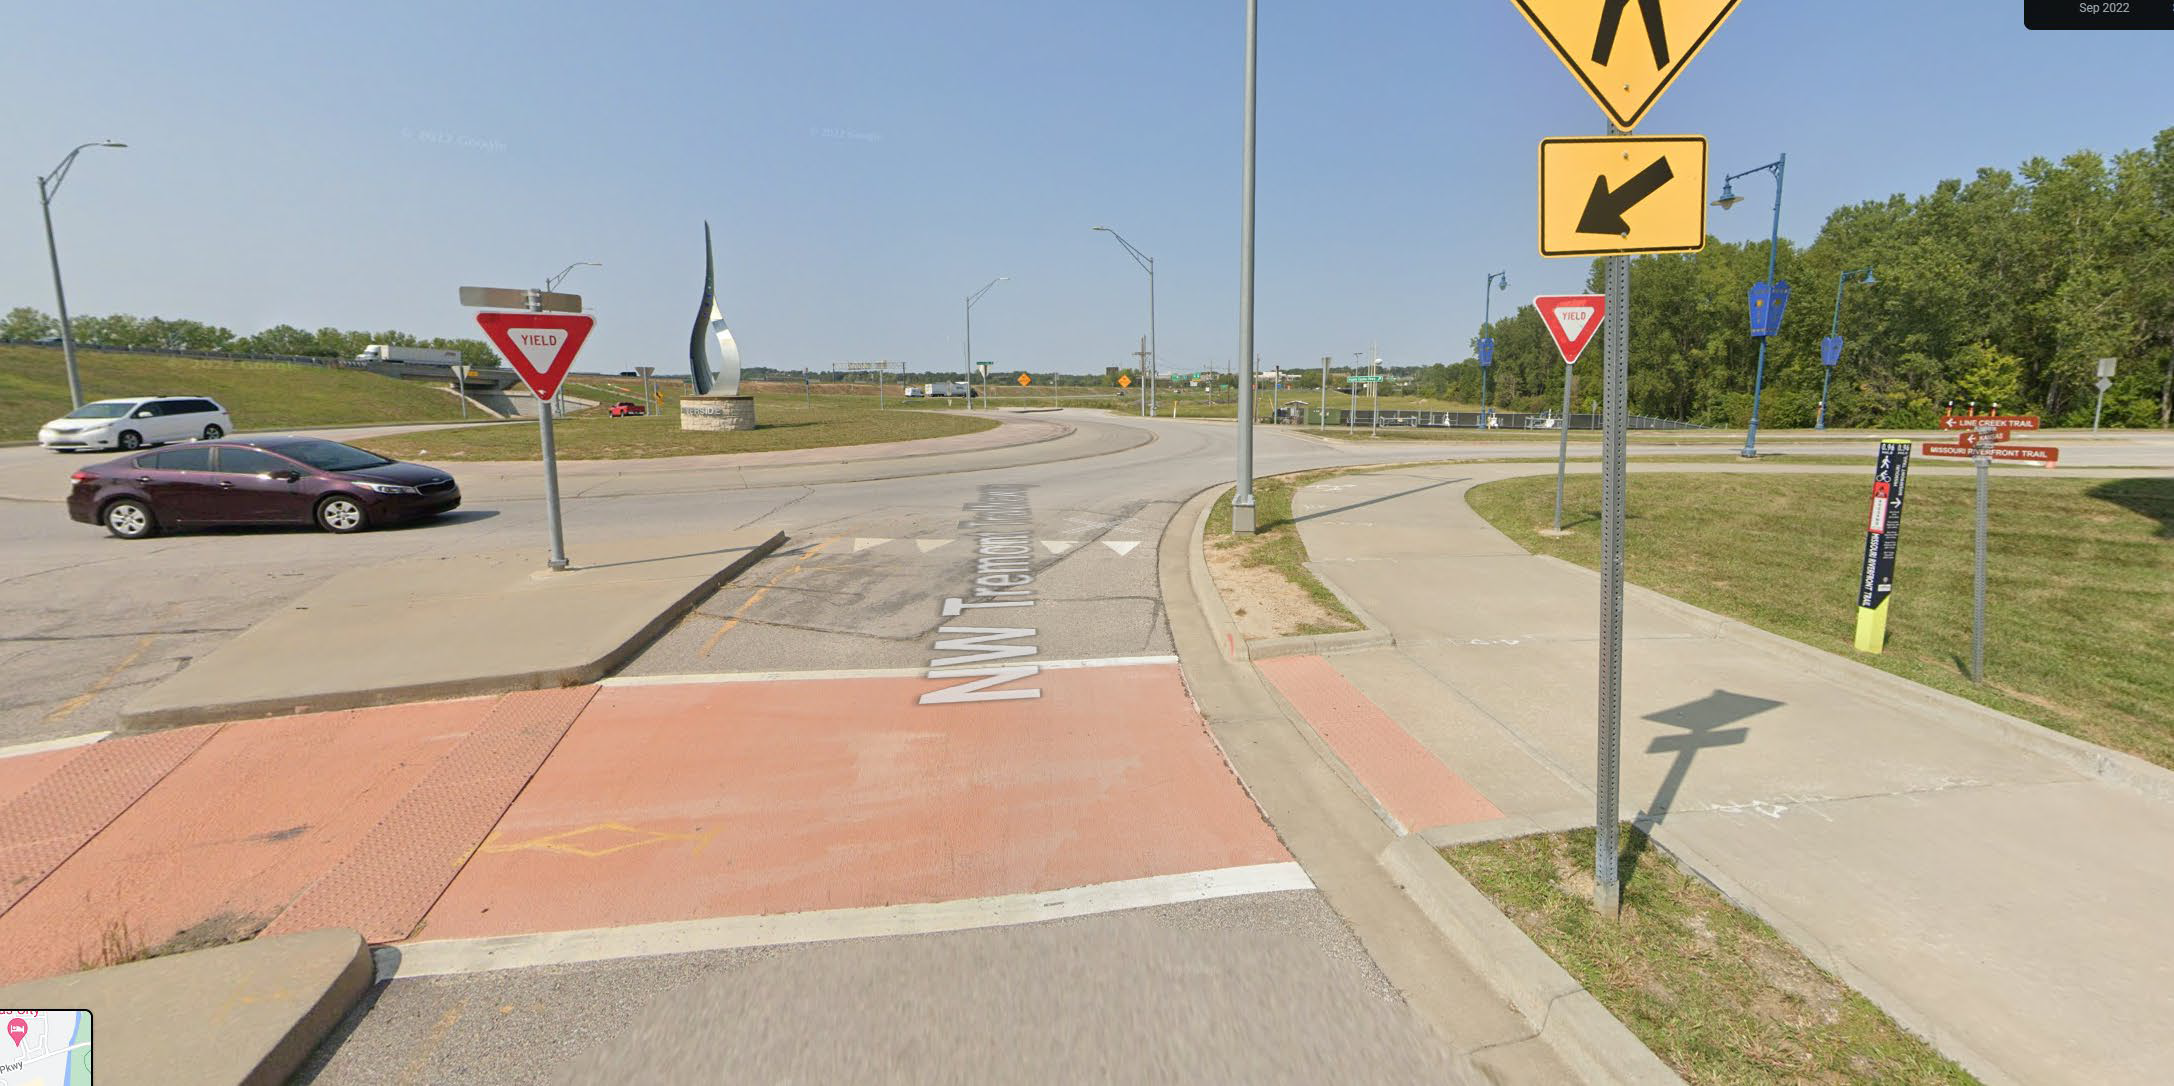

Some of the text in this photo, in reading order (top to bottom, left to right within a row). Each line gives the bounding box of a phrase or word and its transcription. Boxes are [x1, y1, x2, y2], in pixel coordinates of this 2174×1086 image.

[1563, 311, 1587, 321] YIELD
[521, 334, 557, 346] YIELD
[1979, 420, 2007, 428] CREEK
[1930, 446, 2048, 458] MISSOURI RIVERFRONT TRAIL
[1869, 533, 1879, 558] MISSOURI
[1865, 558, 1876, 591] RIVERFRONT
[1862, 591, 1871, 606] TRAIL
